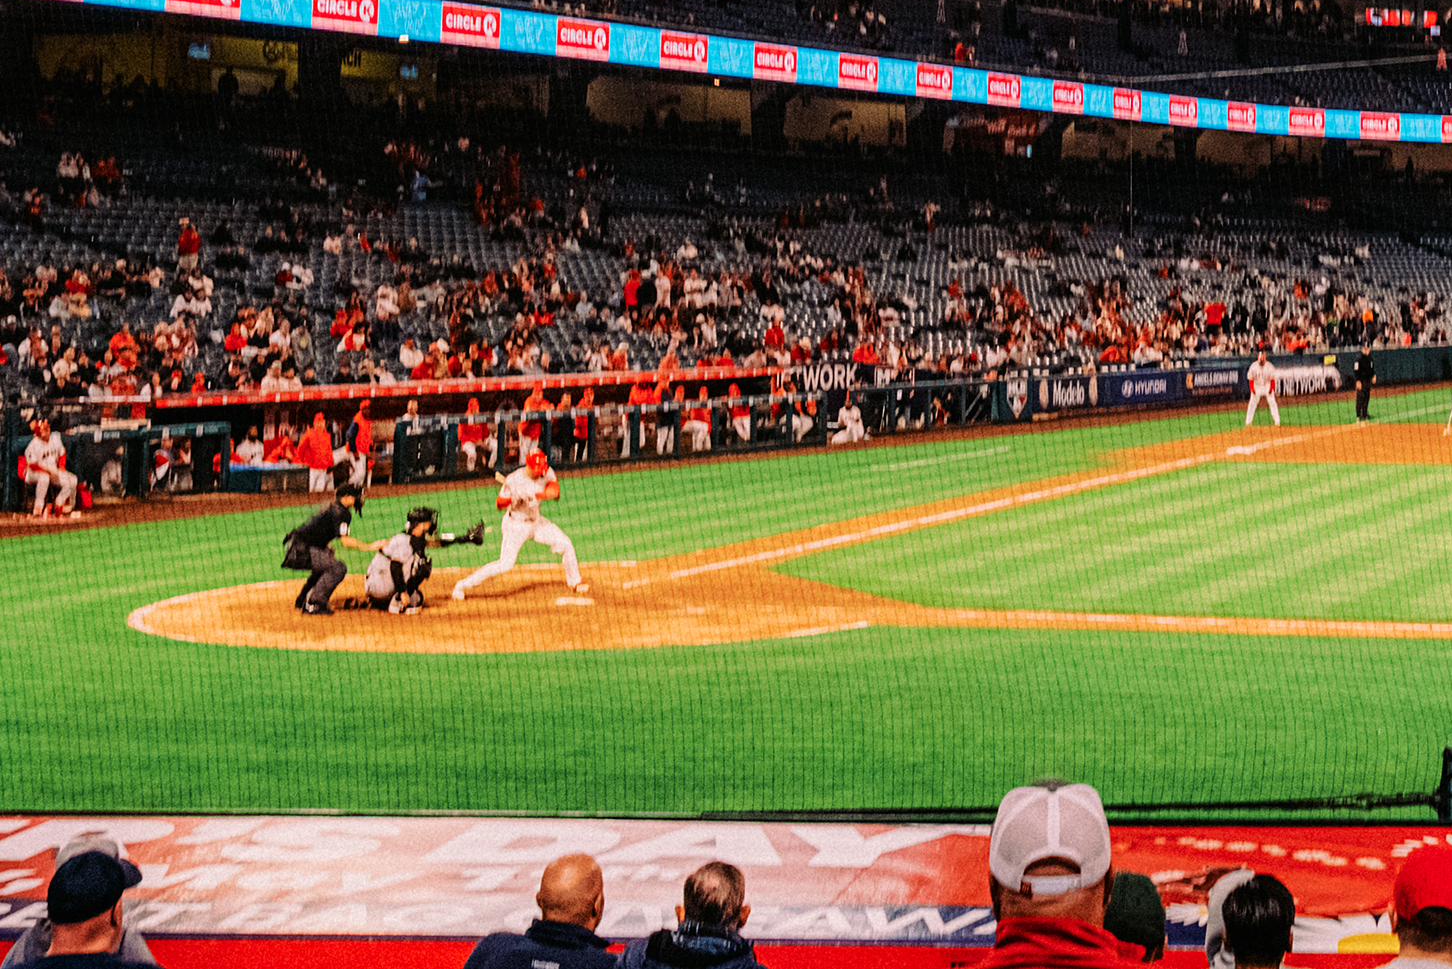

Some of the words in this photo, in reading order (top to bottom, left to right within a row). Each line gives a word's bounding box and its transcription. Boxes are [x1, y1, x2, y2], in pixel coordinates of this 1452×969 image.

[446, 12, 481, 32] CIRCLE
[560, 27, 592, 46] CIRCLE
[664, 40, 692, 58] CIRCLE
[757, 52, 783, 68] CIRCLE
[842, 62, 866, 78] CIRCLE
[918, 72, 940, 87] CIRCLE
[1053, 380, 1084, 406] Modelo
[1134, 380, 1166, 396] HYUNDAI
[422, 821, 955, 868] DAY
[218, 902, 471, 928] BAG
